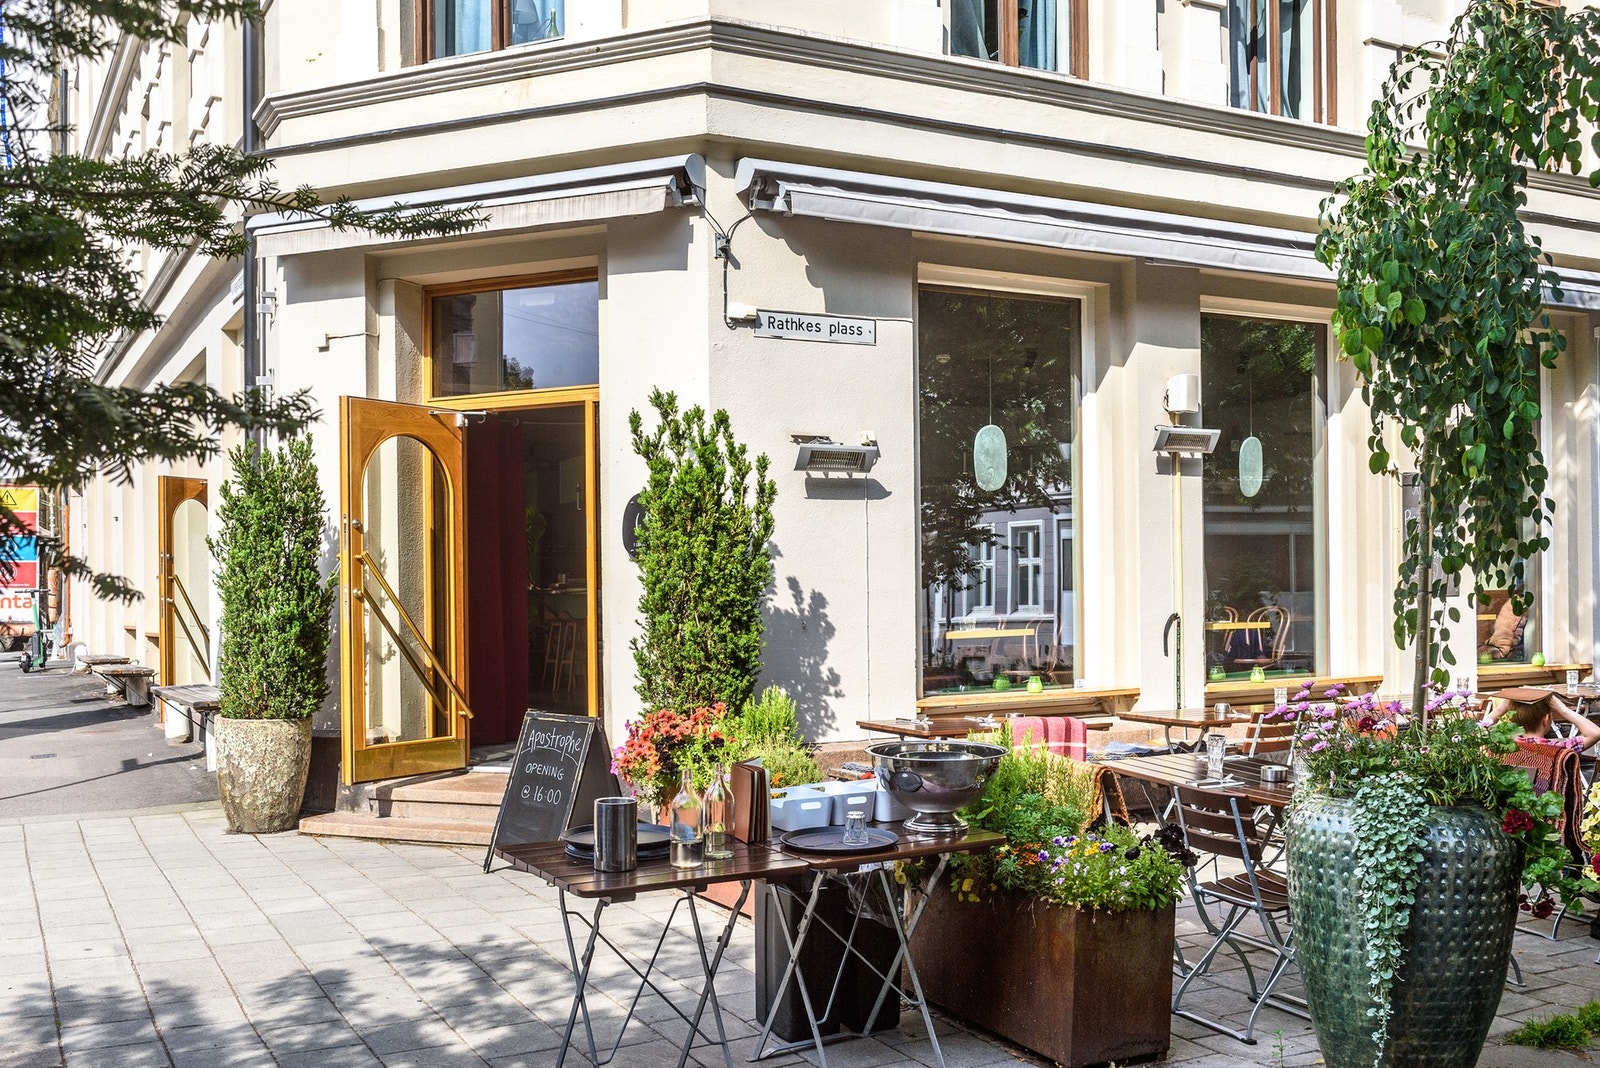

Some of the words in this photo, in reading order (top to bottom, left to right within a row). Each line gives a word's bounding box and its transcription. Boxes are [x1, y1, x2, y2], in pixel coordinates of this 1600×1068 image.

[767, 315, 821, 333] Rathkes
[829, 321, 863, 337] plass
[527, 727, 581, 762] Apostrophe
[525, 763, 564, 781] OPENING
[521, 784, 530, 799] @
[533, 785, 562, 805] 16:00
